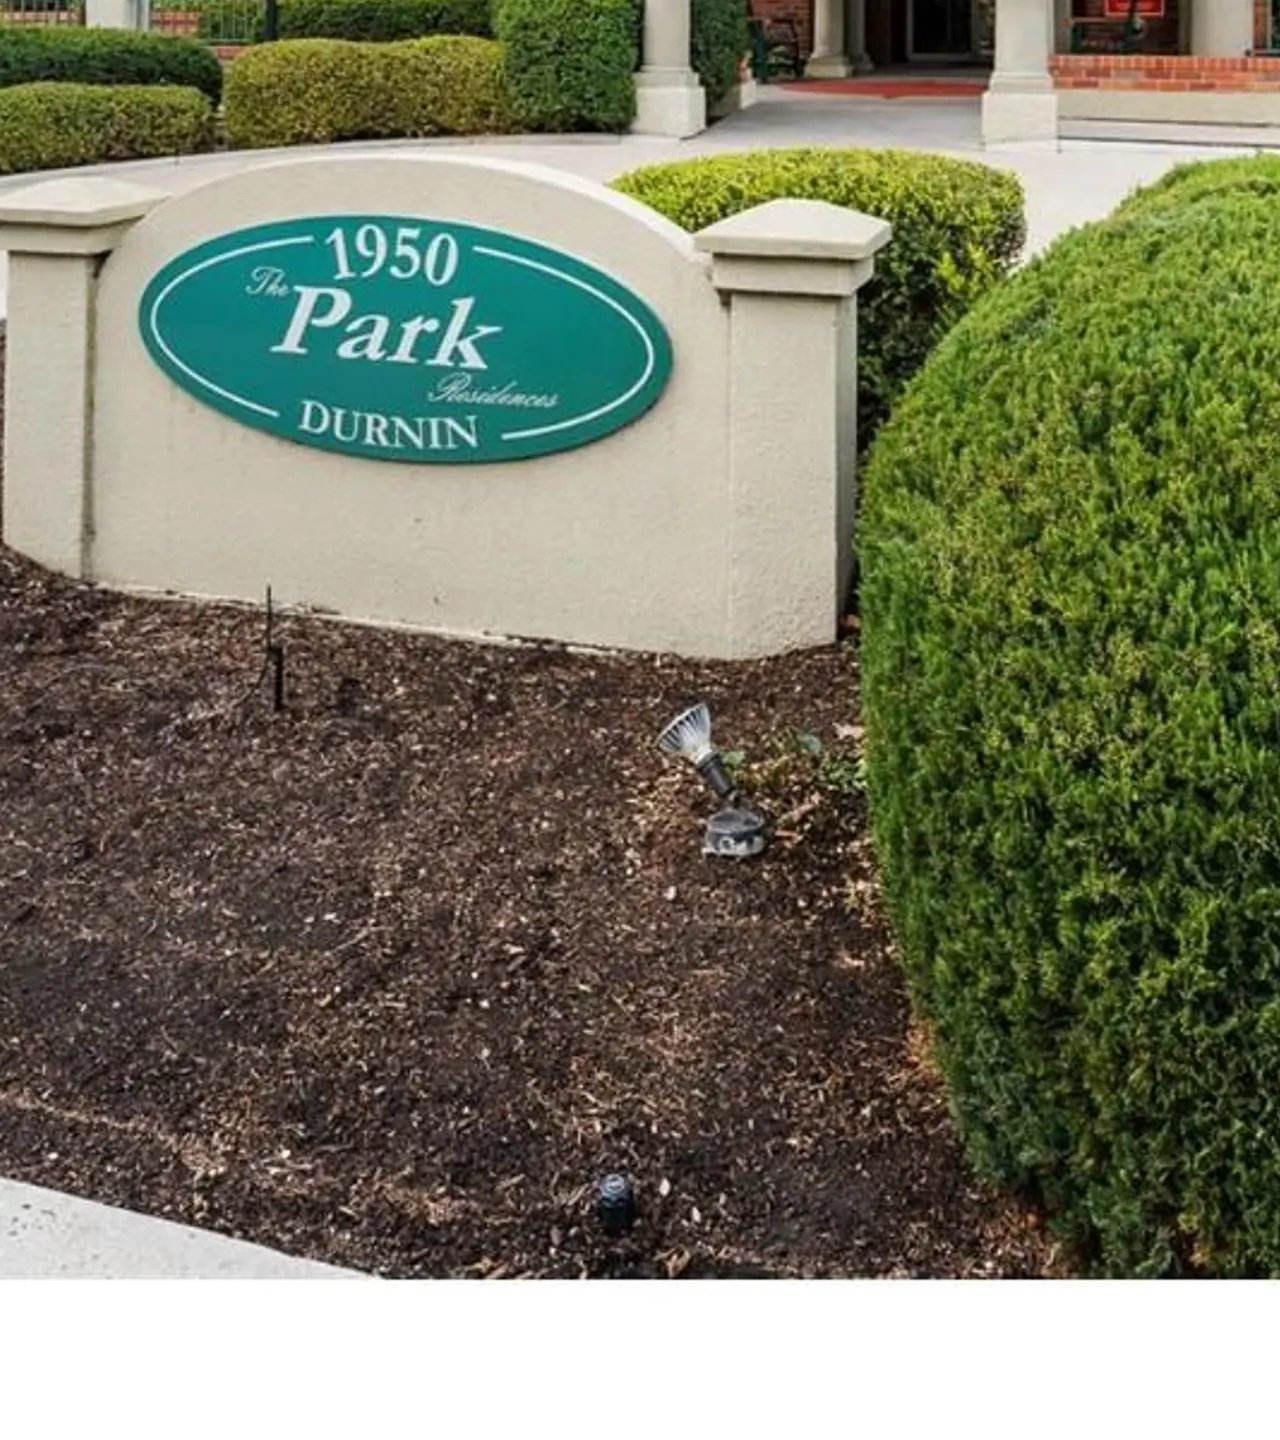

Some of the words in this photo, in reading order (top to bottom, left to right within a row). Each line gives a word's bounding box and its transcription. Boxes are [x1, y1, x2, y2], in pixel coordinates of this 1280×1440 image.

[325, 223, 459, 286] 1950
[244, 265, 289, 297] The
[269, 284, 503, 370] Park
[426, 371, 561, 408] Residences
[297, 398, 480, 450] DURNIN
